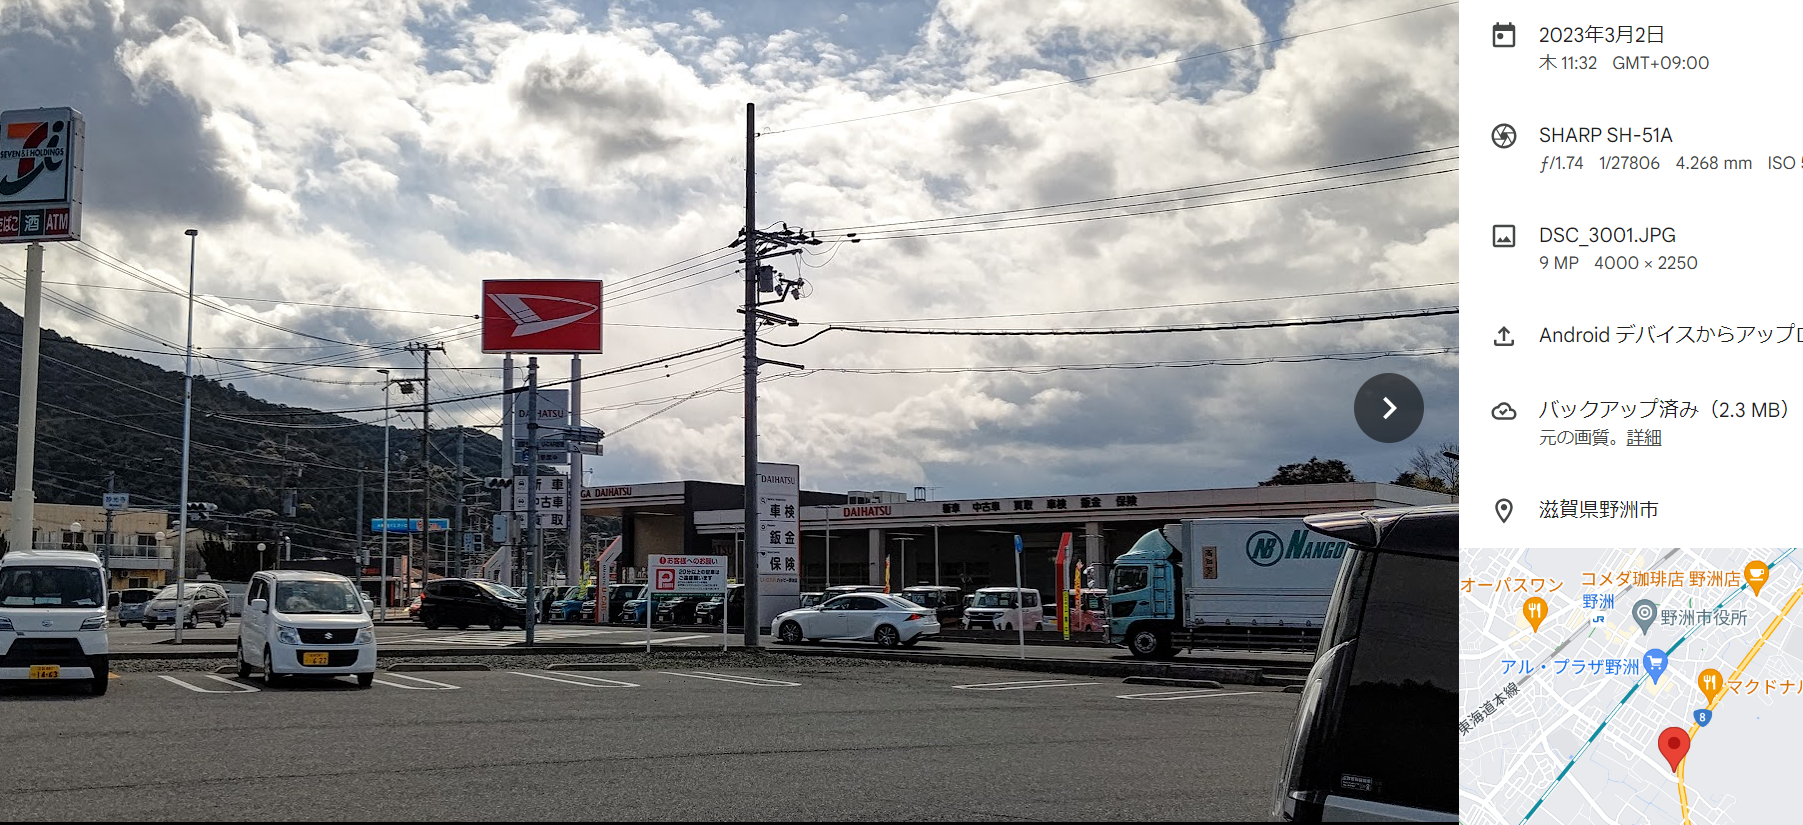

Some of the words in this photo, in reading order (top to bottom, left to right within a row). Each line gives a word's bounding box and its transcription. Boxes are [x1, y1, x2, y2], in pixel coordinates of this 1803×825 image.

[30, 147, 64, 157] HOLDINGS
[24, 214, 40, 232] 酒
[46, 213, 69, 230] ATM
[519, 409, 564, 419] DAHATSU
[761, 475, 796, 485] DAIHATSU
[595, 486, 632, 498] DAIHATSU
[843, 505, 892, 518] DAIHATSU
[972, 501, 1000, 513] 中古車
[1284, 529, 1349, 559] NANGO
